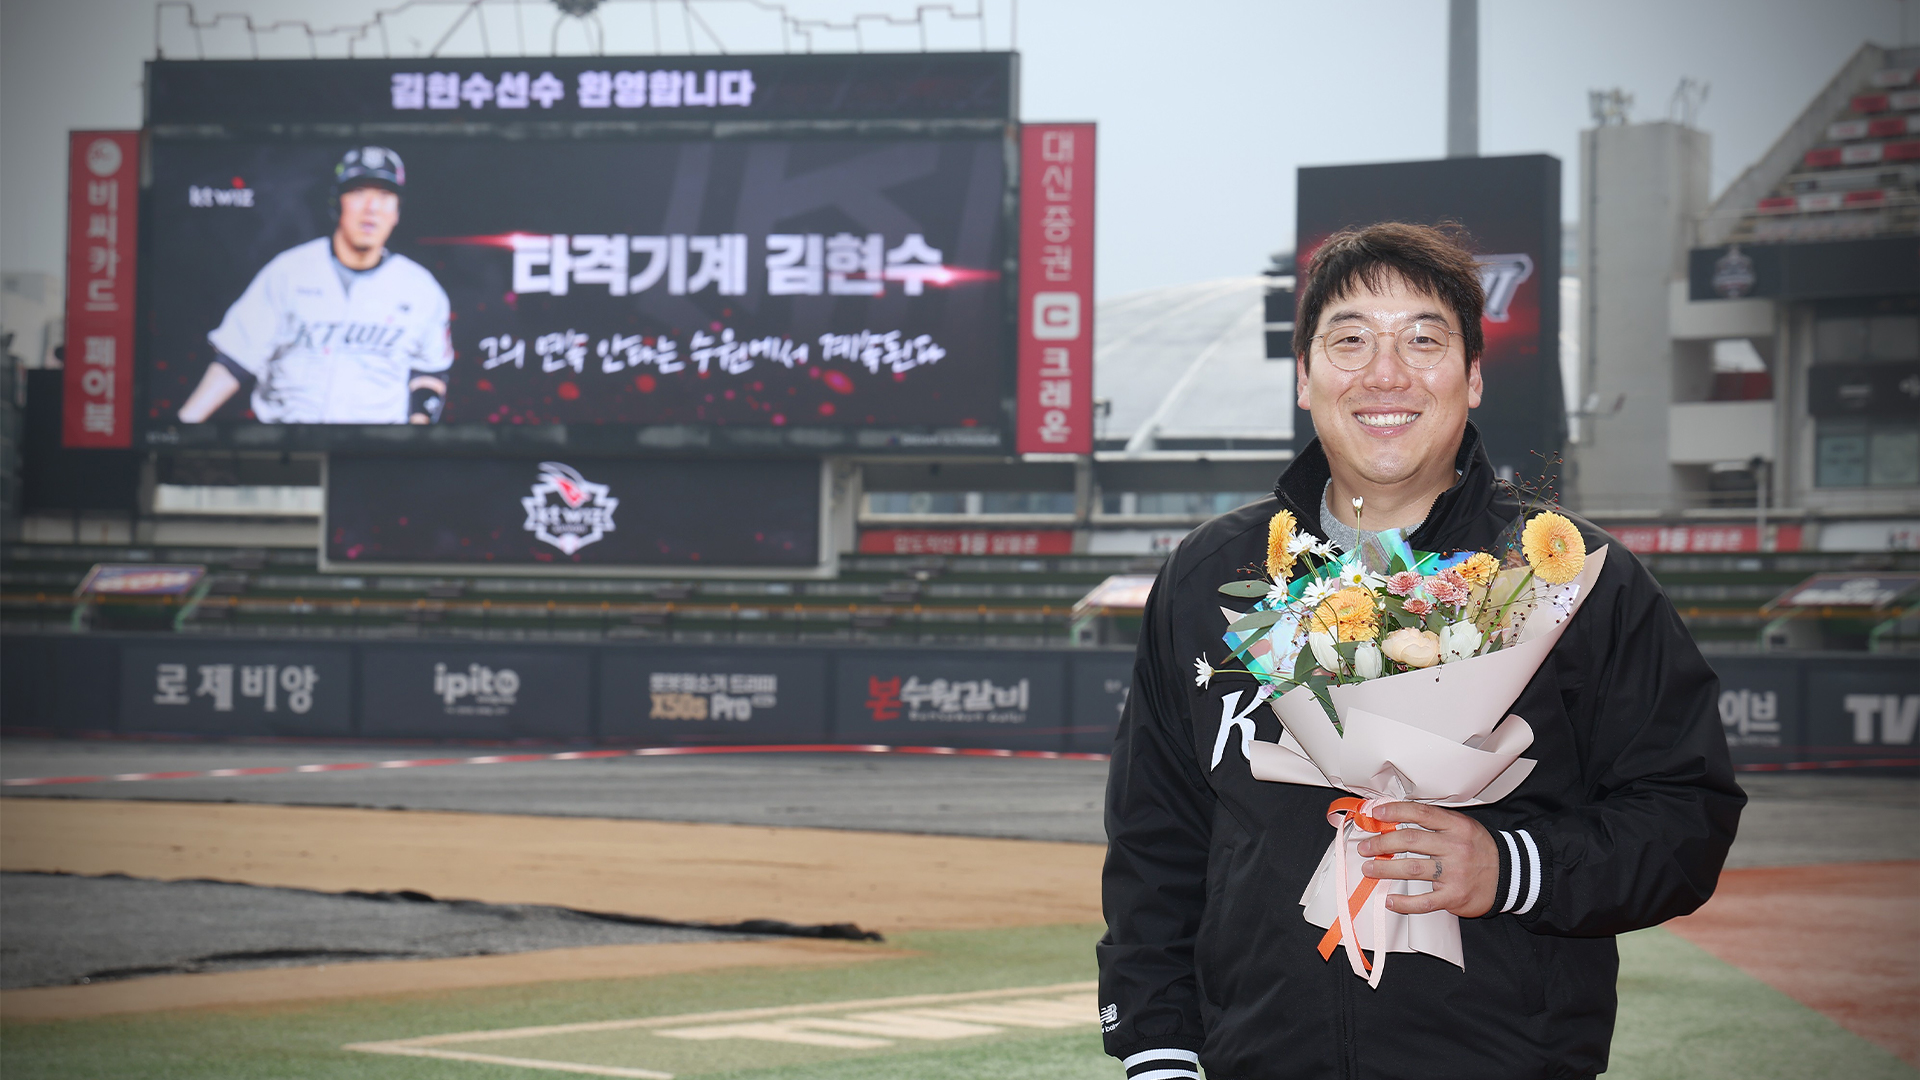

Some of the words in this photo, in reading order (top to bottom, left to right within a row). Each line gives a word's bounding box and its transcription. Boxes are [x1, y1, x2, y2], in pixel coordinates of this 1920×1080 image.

[391, 71, 565, 109] 김현수선수
[577, 69, 755, 108] 환영합니다
[1040, 130, 1075, 282] 대신증권
[85, 179, 119, 312] 비씨카드
[512, 233, 748, 296] 타격기계
[765, 233, 943, 296] 김현수
[479, 333, 526, 370] 그의
[596, 332, 686, 374] 안타는
[690, 328, 809, 375] 수원에서
[818, 329, 947, 375] 계속된다
[81, 336, 116, 436] 페이북
[1037, 346, 1072, 443] 크레온
[153, 663, 319, 714] 로제비앙
[434, 662, 520, 705] ipito
[649, 692, 708, 720] X50s
[710, 692, 751, 720] Pro
